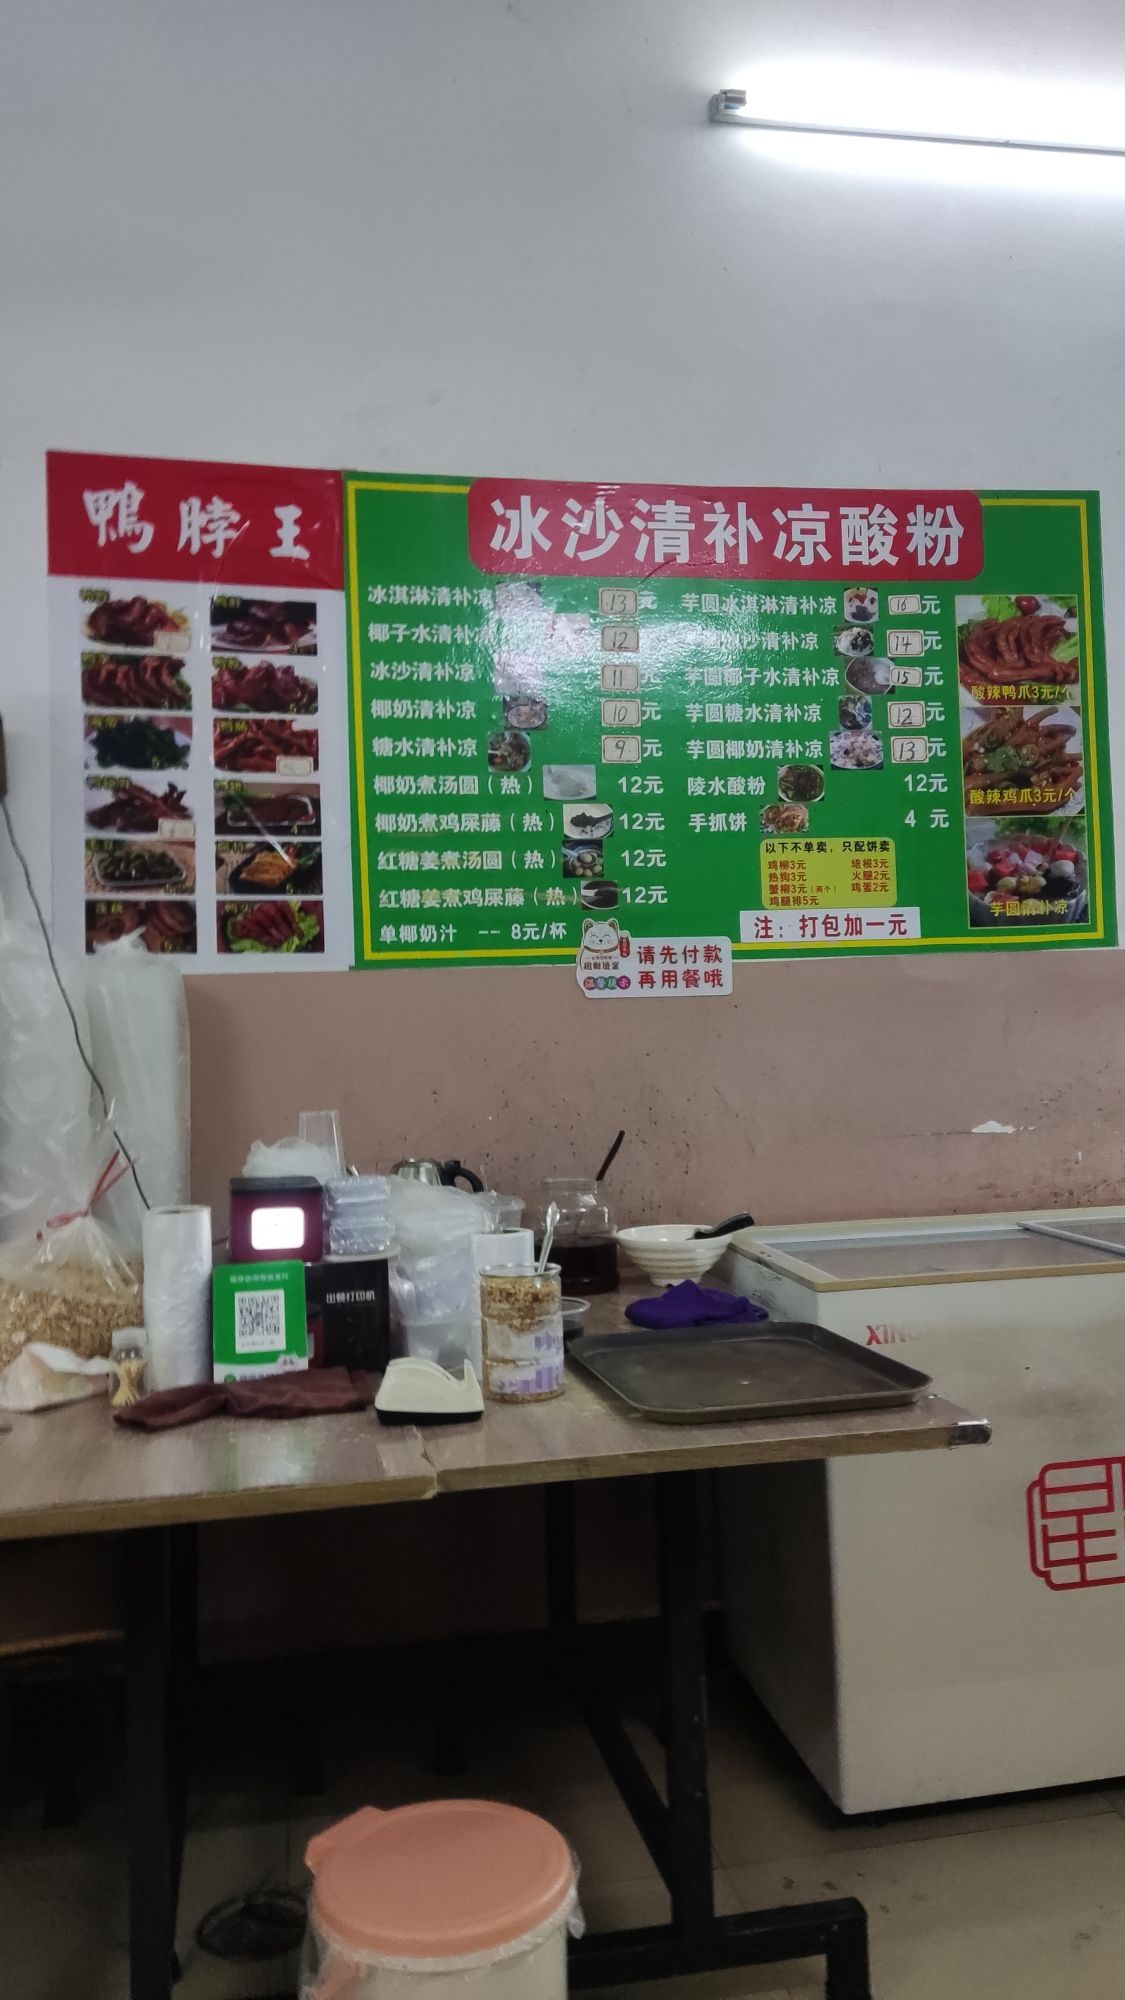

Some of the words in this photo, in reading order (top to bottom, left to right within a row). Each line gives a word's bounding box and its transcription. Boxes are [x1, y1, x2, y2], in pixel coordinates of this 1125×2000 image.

[82, 480, 311, 560] 鸭脖王
[490, 495, 964, 566] 冰沙清补凉酸粉
[367, 585, 496, 609] 冰淇淋清补凉
[681, 592, 837, 616] 芋圆冰淇淋清补凉
[921, 595, 941, 615] 元
[610, 631, 629, 650] 12
[923, 631, 943, 651] 元
[370, 661, 476, 683] 冰沙清补凉
[684, 665, 840, 687] 芋圆椰子水清补凉
[924, 667, 944, 686] 元
[371, 698, 477, 720] 椰奶清补凉
[642, 702, 662, 722] 元
[685, 702, 822, 725] 芋圆糖水清补凉
[926, 702, 945, 722] 元
[372, 736, 478, 759] 糖水清补凉
[643, 738, 663, 759] 元
[686, 737, 824, 760] 芋圆椰奶清补凉
[928, 738, 947, 758] 元
[617, 775, 664, 795] 12元
[687, 775, 766, 797] 陵水酸粉
[904, 773, 949, 794] 12元
[619, 812, 666, 832] 12元
[688, 811, 748, 833] 手抓饼
[904, 811, 917, 829] 4
[930, 808, 950, 829] 元
[765, 840, 891, 855] 以下不单卖，只配饼卖
[620, 849, 668, 868] 12元
[767, 859, 807, 871] 鸡柳3元
[767, 871, 808, 883] 热狗3元
[622, 886, 668, 905] 12元
[851, 882, 890, 894] 鸡蛋2元
[379, 924, 457, 945] 单椰奶汁
[511, 922, 568, 942] 8元/杯
[753, 914, 908, 940] 注：打包加一元
[636, 943, 724, 966] 请先付款
[637, 969, 724, 990] 再用餐哦
